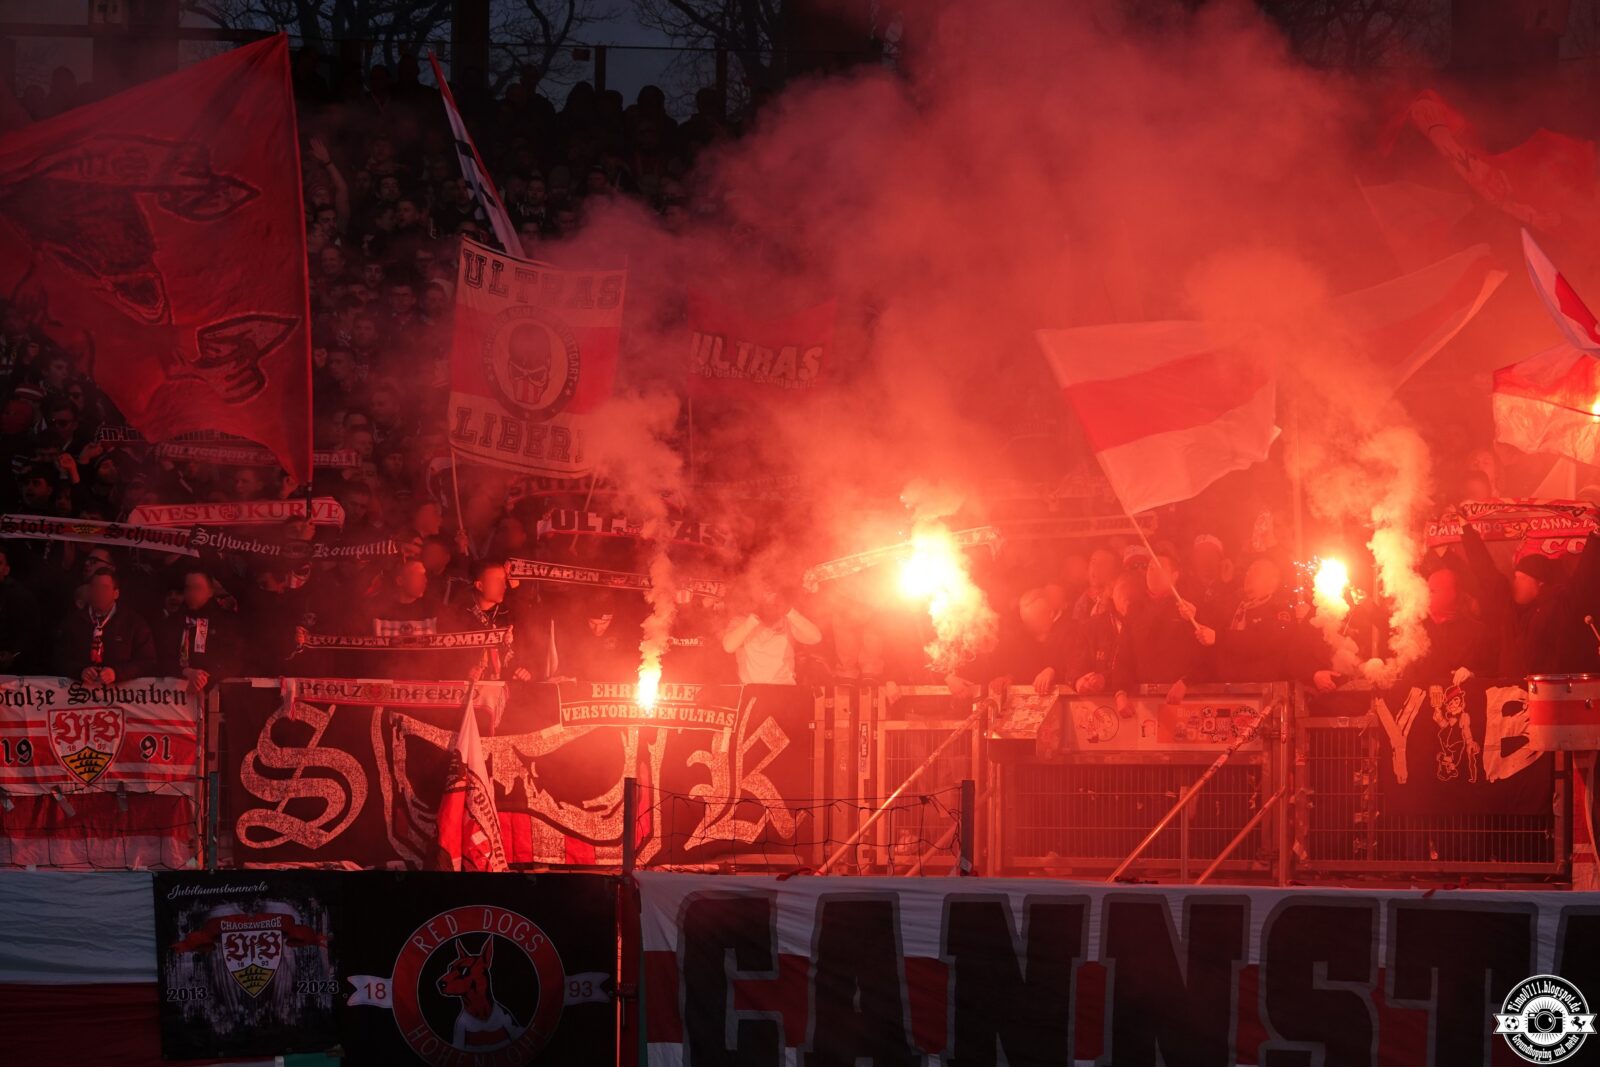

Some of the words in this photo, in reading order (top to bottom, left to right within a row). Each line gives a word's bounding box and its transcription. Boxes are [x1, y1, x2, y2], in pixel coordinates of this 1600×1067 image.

[463, 249, 624, 310] ULTRAS
[690, 331, 824, 382] ULTRAS
[138, 505, 217, 523] WEST
[248, 501, 340, 520] KURVE
[1, 515, 65, 540] Stolze
[191, 527, 281, 557] Schwaben
[0, 685, 55, 711] tolze
[67, 682, 188, 707] Schwaben
[52, 711, 121, 745] VfB
[679, 707, 736, 727] ULTRAS
[1, 738, 33, 765] 19
[140, 735, 172, 761] 91
[220, 916, 282, 931] CHAOSZWERGE
[412, 914, 460, 954] RED
[481, 908, 545, 953] DOGS
[223, 931, 281, 962] VfB
[297, 979, 340, 995] 2023
[568, 980, 594, 998] 93
[676, 888, 1600, 1067] CANNST
[167, 986, 209, 1002] 2013
[363, 982, 387, 1000] 18
